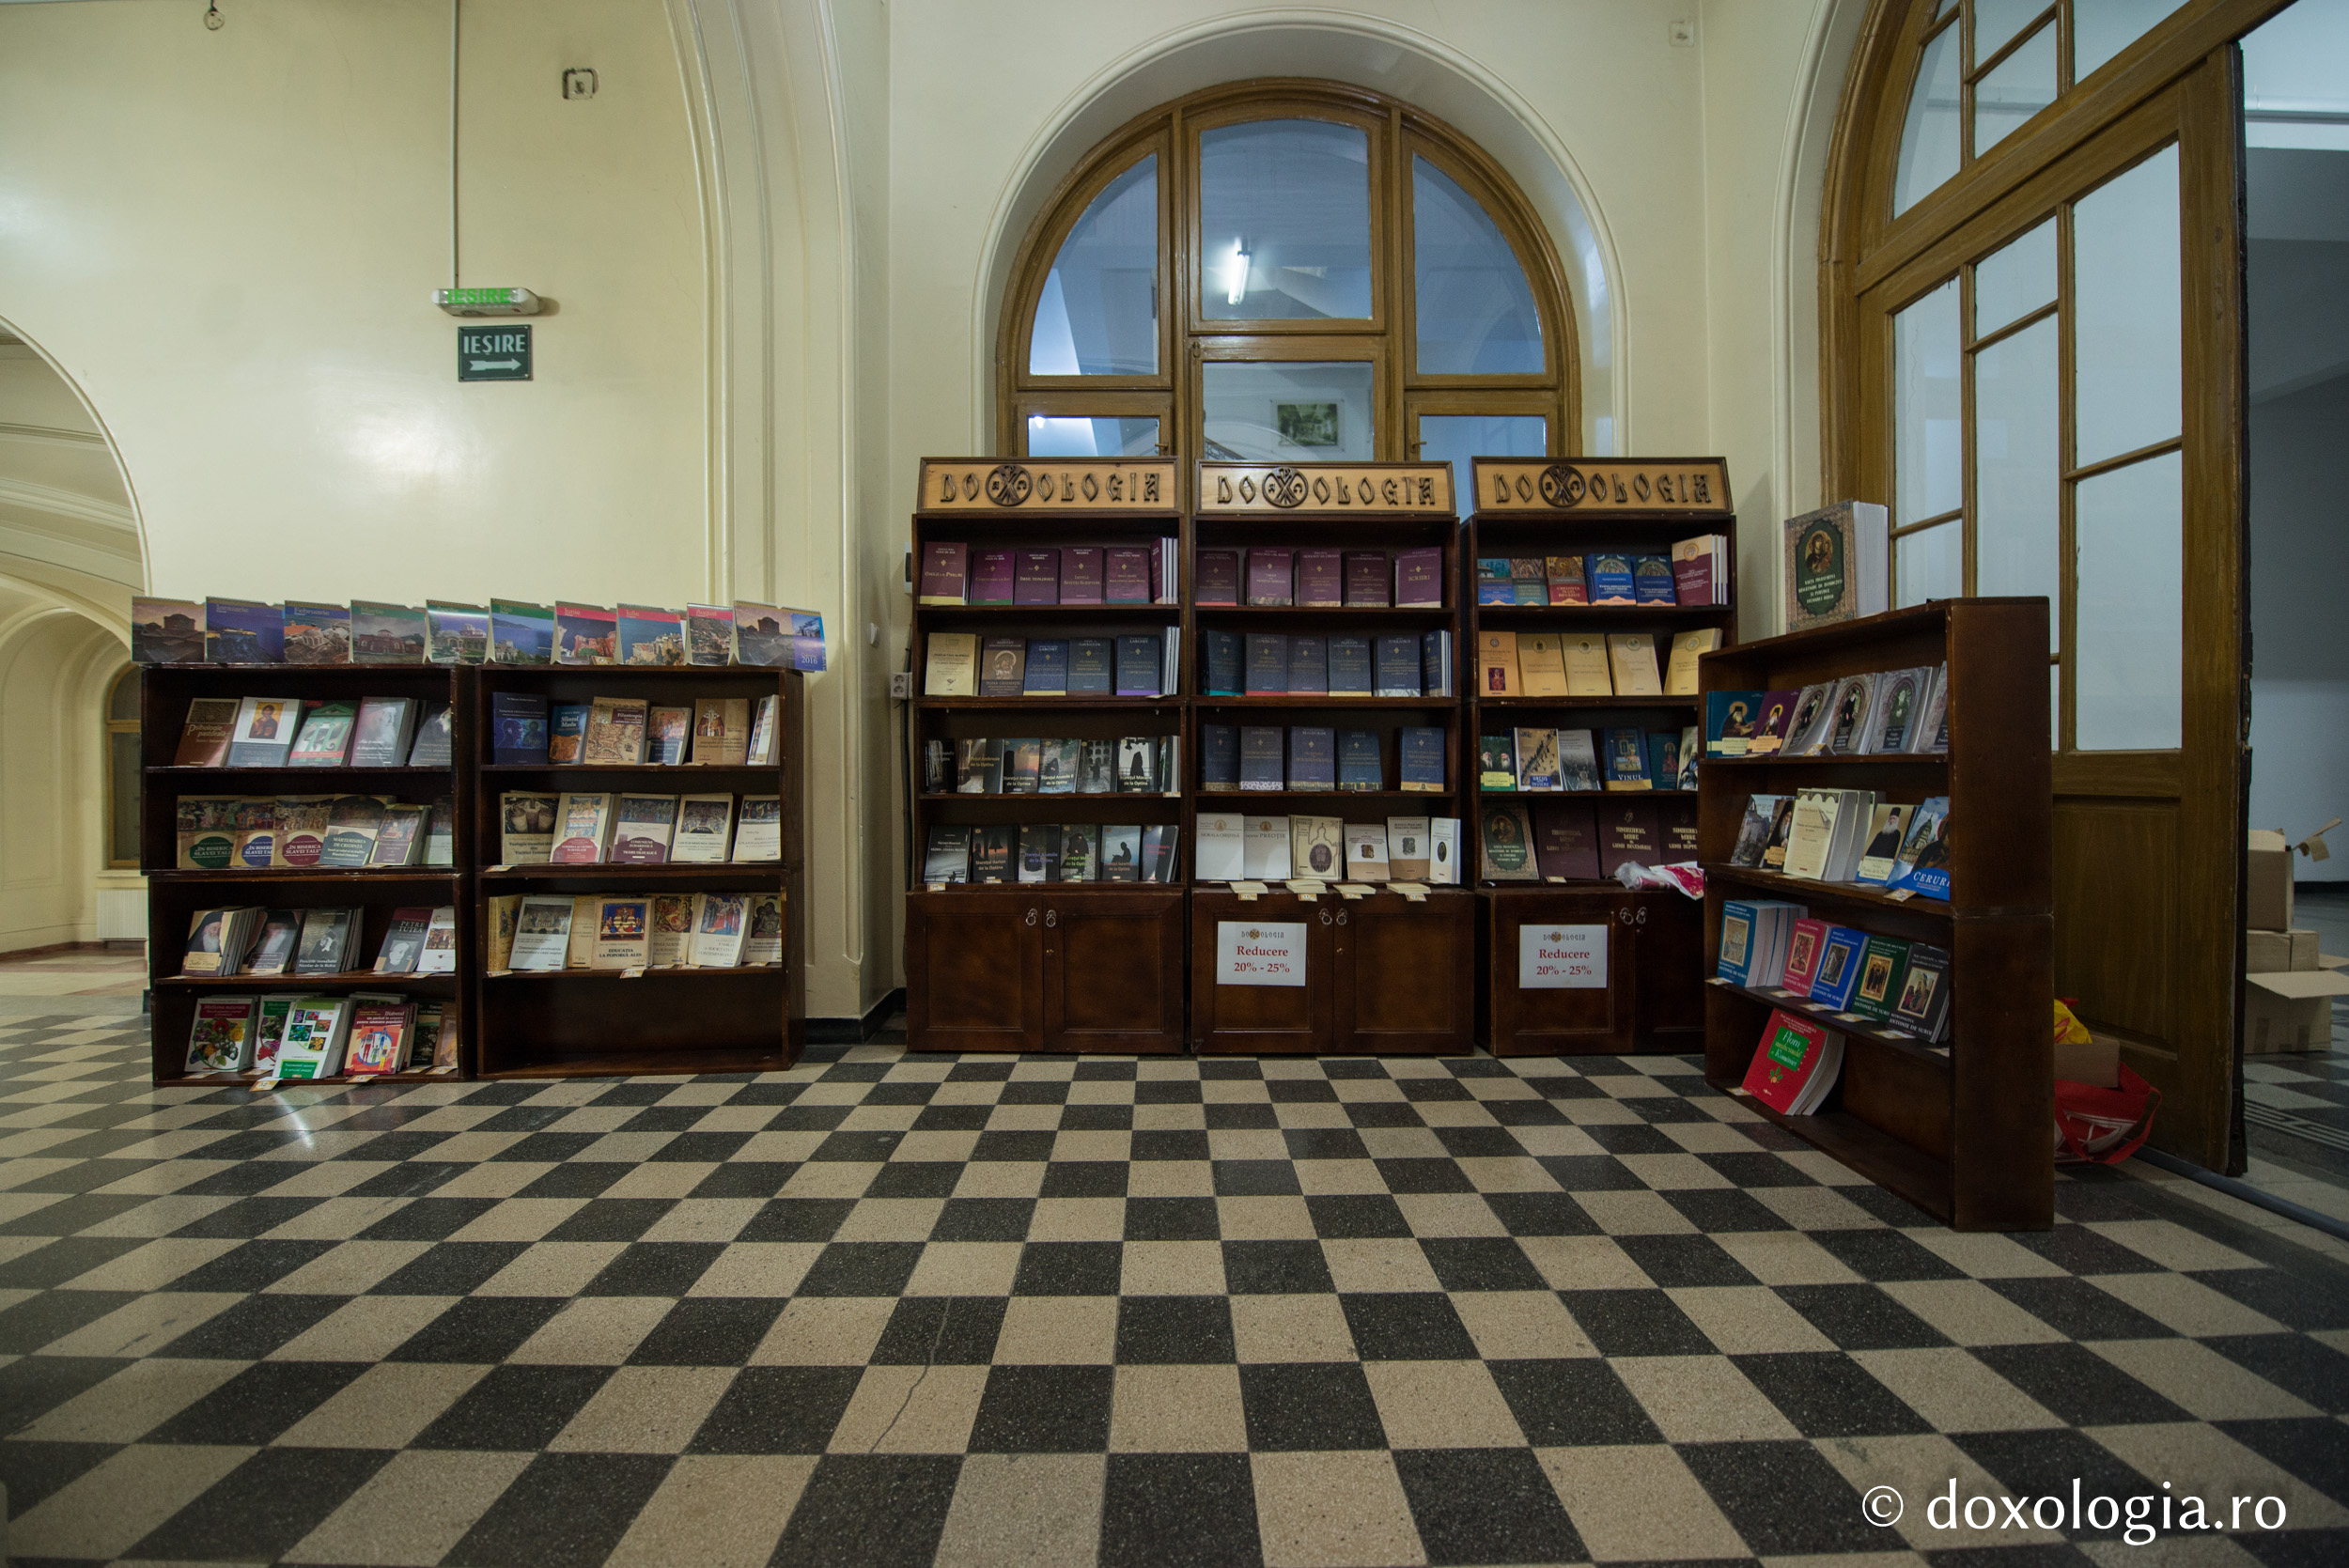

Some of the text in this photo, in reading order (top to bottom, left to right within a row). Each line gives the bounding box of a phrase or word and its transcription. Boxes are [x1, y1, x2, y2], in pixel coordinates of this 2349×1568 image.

[801, 656, 818, 664] 2016
[1237, 945, 1289, 956] Reducere
[1539, 949, 1590, 959] Reducere
[1234, 962, 1257, 972] 20%
[1267, 963, 1290, 973] 25%
[1536, 965, 1560, 975] 20%
[1569, 965, 1592, 975] 25%
